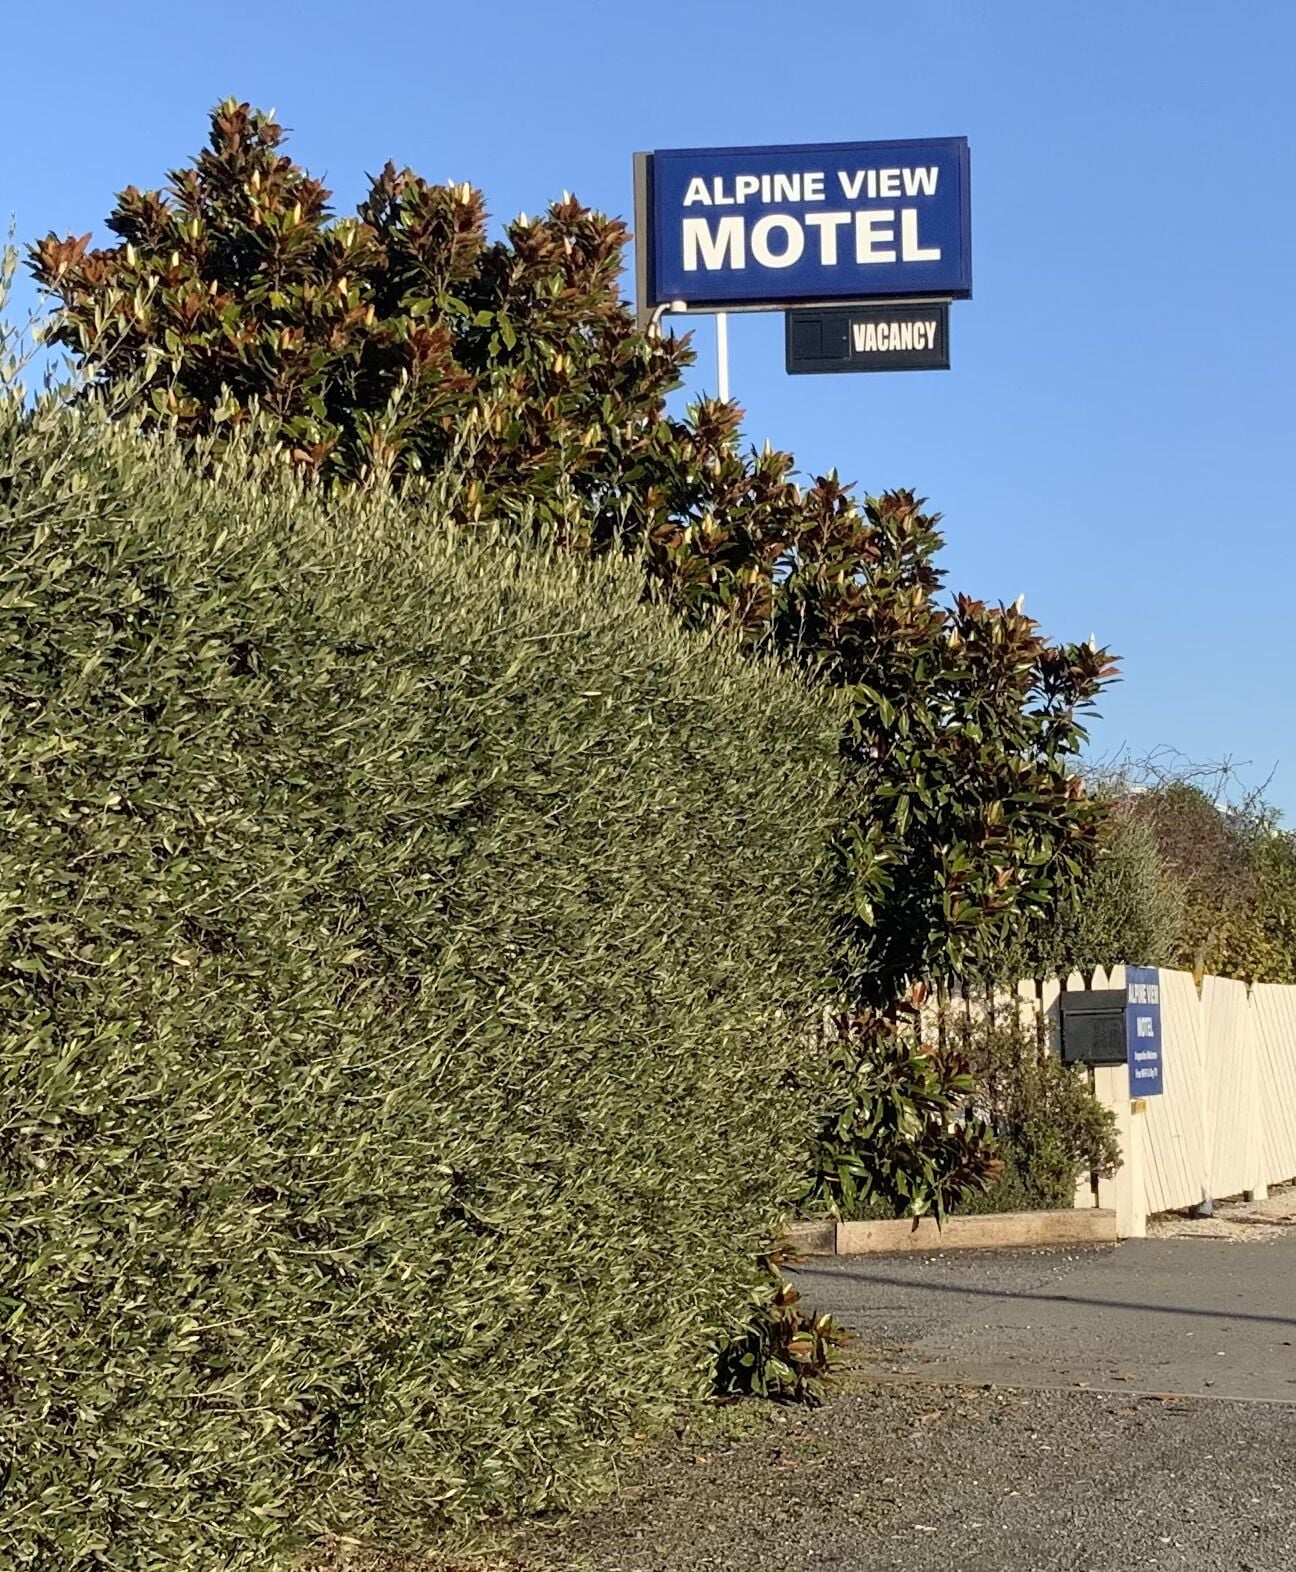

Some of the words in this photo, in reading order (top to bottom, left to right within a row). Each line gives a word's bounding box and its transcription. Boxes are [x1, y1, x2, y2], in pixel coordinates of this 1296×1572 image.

[682, 171, 826, 207] ALPINE
[837, 166, 939, 199] VIEW
[682, 208, 942, 272] MOTEL
[852, 321, 937, 352] VACANCY
